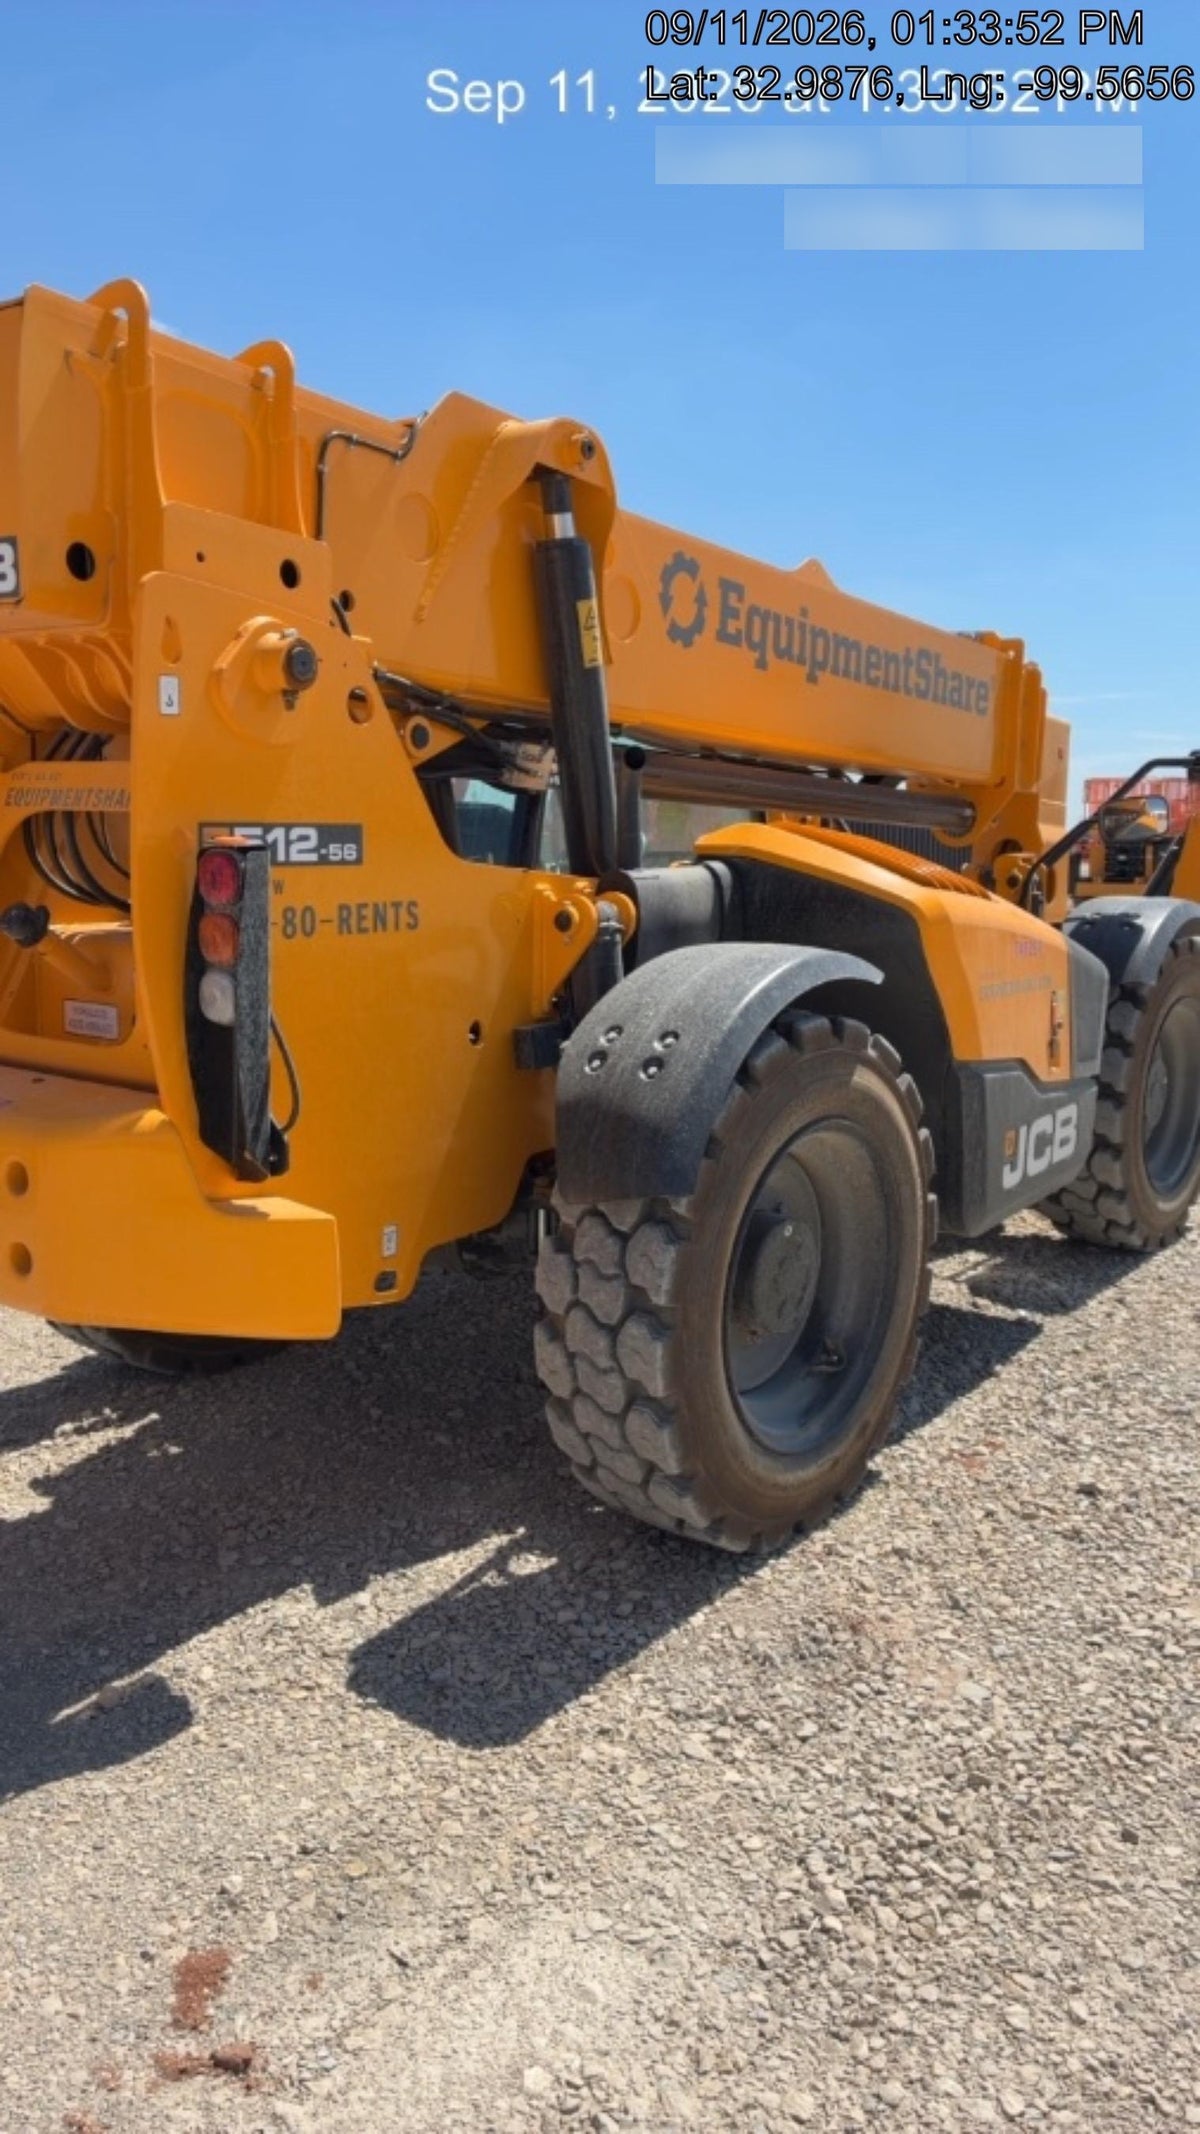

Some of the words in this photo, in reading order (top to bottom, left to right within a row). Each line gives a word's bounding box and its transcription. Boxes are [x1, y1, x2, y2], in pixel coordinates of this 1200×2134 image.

[715, 576, 990, 716] EquipmentShare
[5, 786, 131, 808] EQUIPMENTSHA
[1002, 1102, 1079, 1190] JCB
